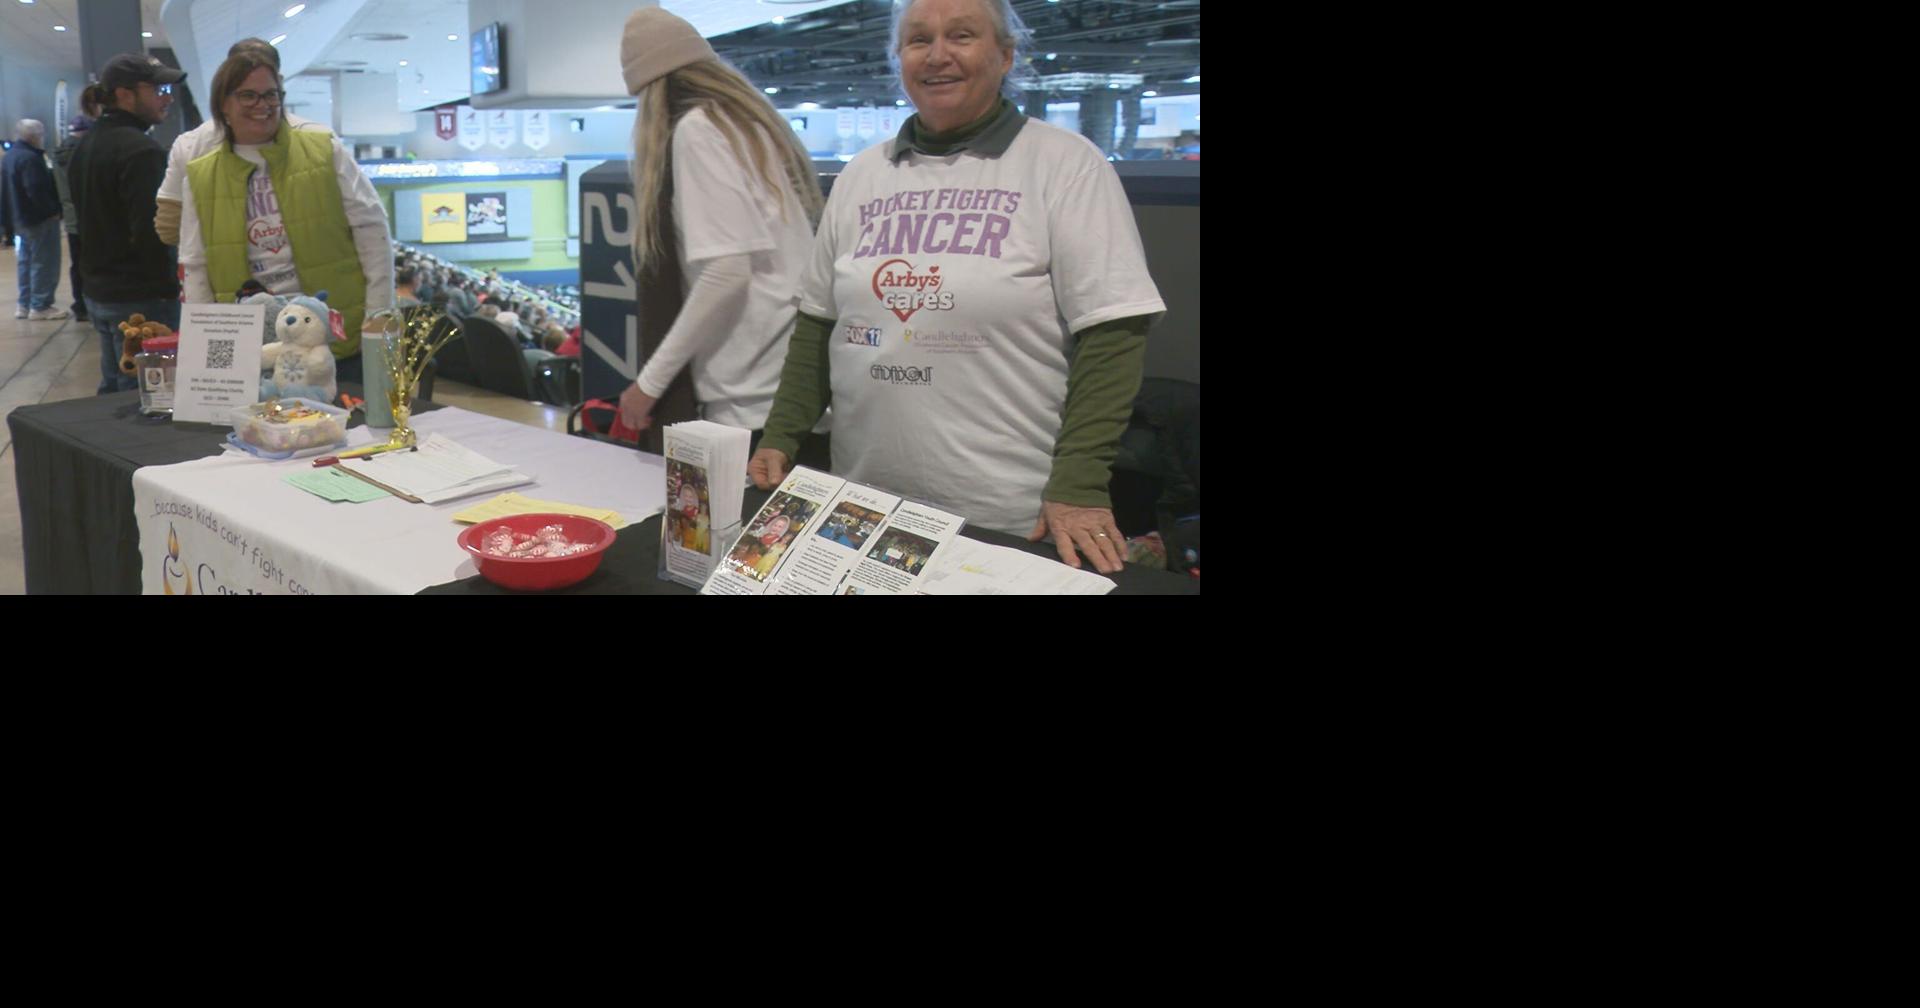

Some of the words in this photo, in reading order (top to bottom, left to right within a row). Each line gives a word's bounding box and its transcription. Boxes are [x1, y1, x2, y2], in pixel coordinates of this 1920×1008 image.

[858, 189, 935, 226] HOCKEY
[934, 188, 1022, 214] FIGHTS
[852, 213, 1011, 261] CANCER
[583, 191, 638, 381] 217
[882, 292, 955, 311] cares
[150, 500, 193, 519] because
[195, 504, 218, 533] kids
[220, 526, 249, 556] can't
[251, 547, 285, 585] fight
